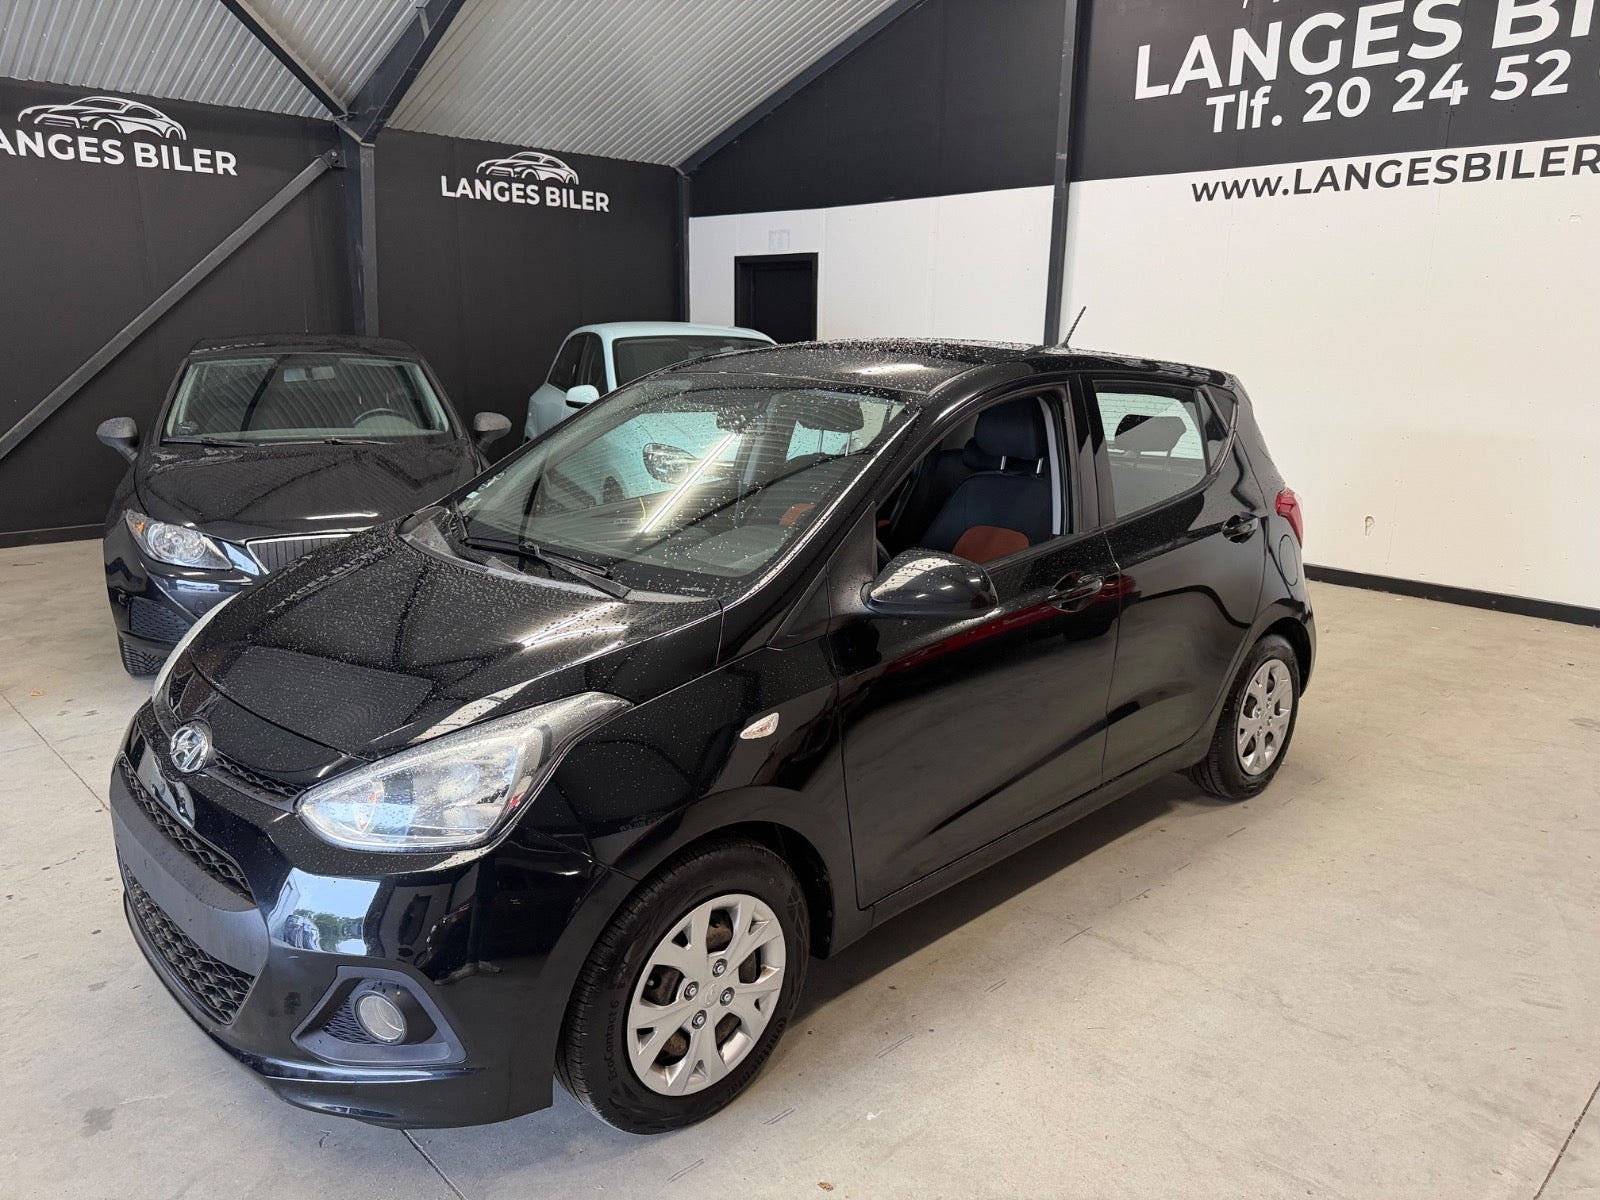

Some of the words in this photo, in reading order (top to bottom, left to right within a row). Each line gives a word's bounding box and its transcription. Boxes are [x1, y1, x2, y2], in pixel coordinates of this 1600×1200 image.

[1135, 0, 1463, 99] LANGES
[1206, 86, 1283, 133] Tlf.
[1303, 77, 1371, 122] 20
[1392, 63, 1468, 112] 24
[1490, 50, 1571, 100] 52
[134, 142, 238, 176] BILER
[441, 175, 540, 205] LANGES
[545, 187, 609, 212] BILER
